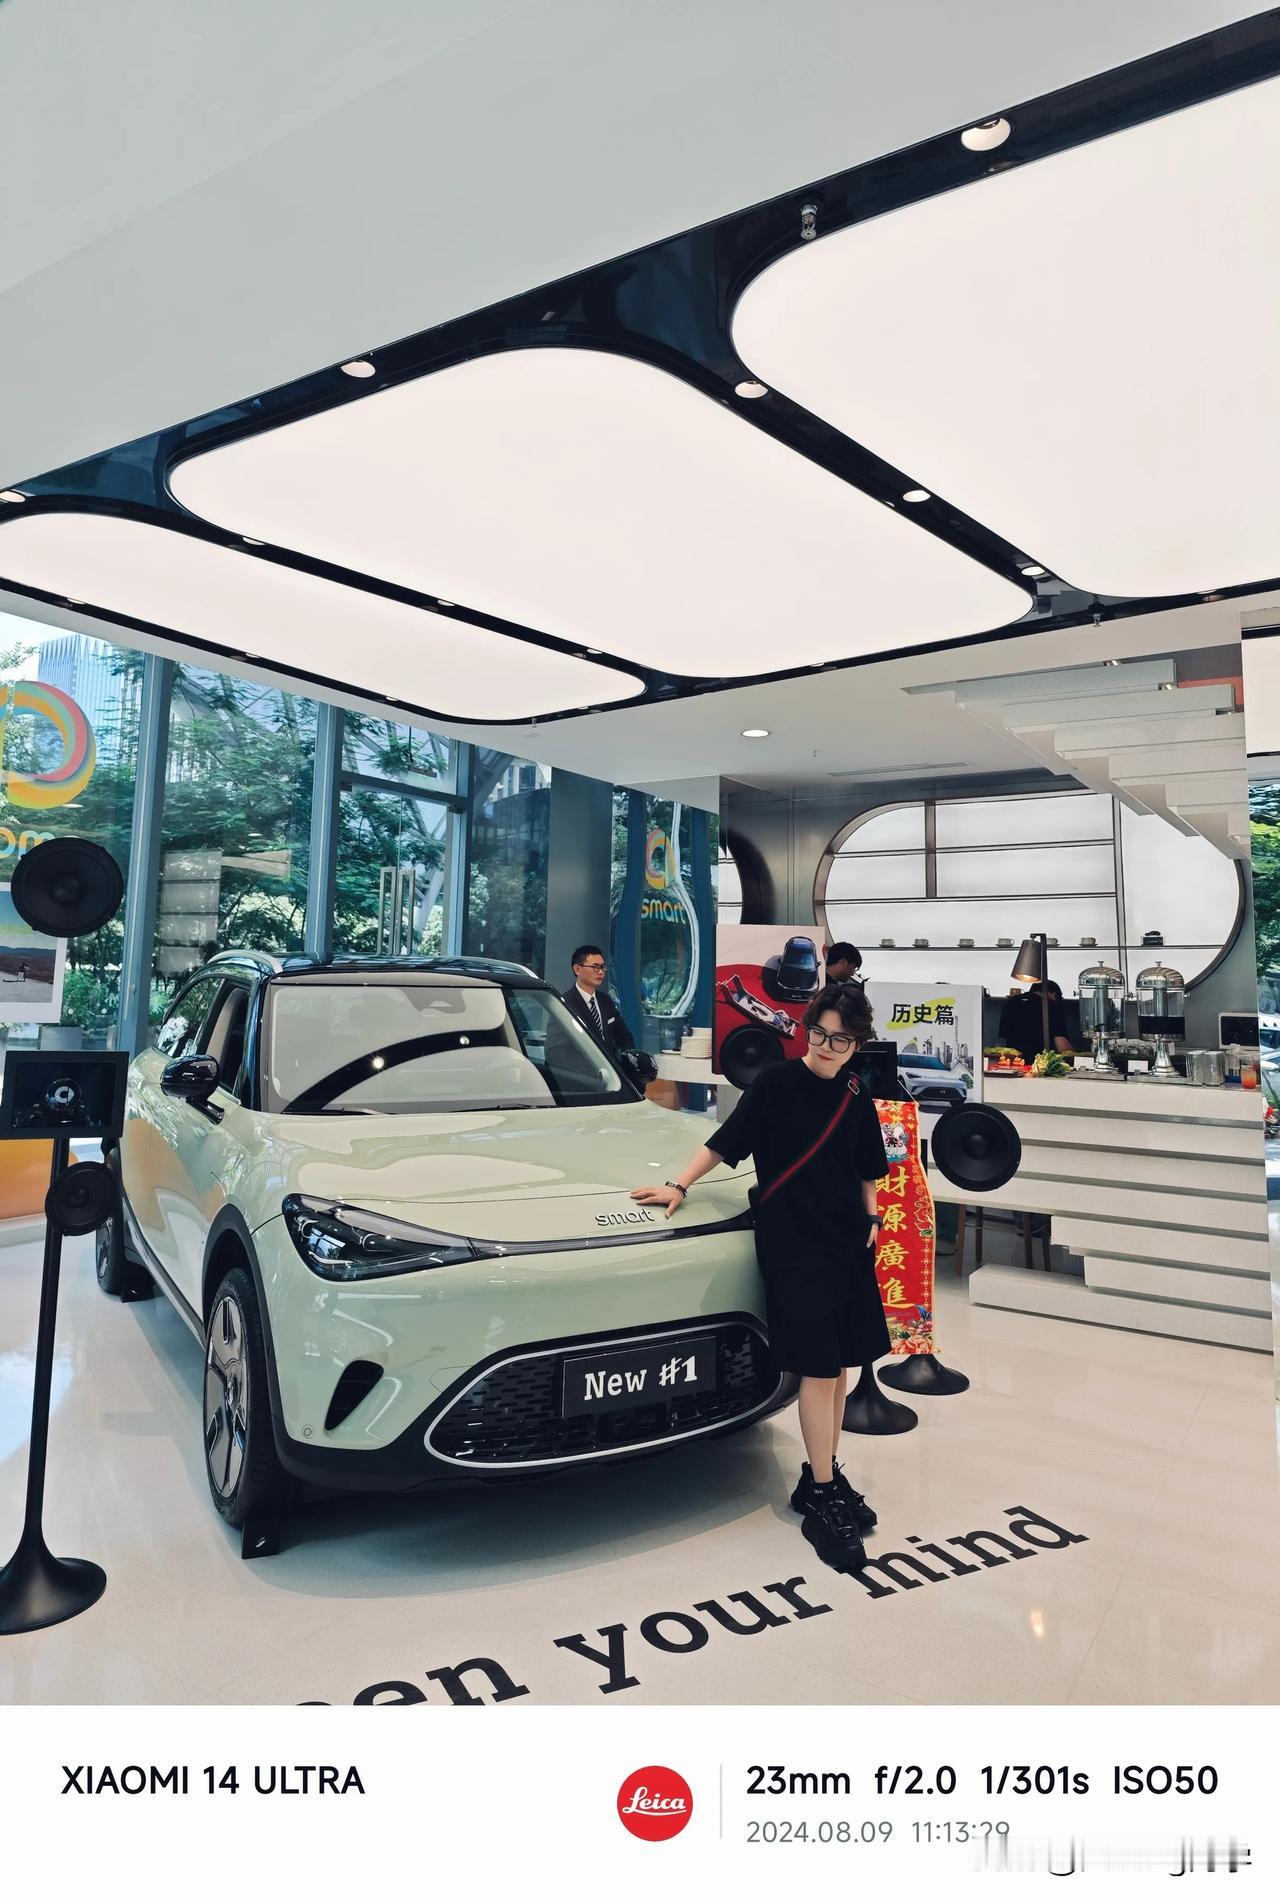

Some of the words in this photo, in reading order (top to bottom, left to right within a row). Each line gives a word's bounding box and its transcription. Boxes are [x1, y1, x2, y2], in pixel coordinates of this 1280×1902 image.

[641, 898, 686, 925] smart
[891, 1003, 955, 1026] 历史篇
[595, 1208, 655, 1227] smart
[583, 1369, 648, 1401] New
[658, 1355, 698, 1387] #1
[554, 1576, 834, 1695] your
[833, 1505, 1090, 1600] mind
